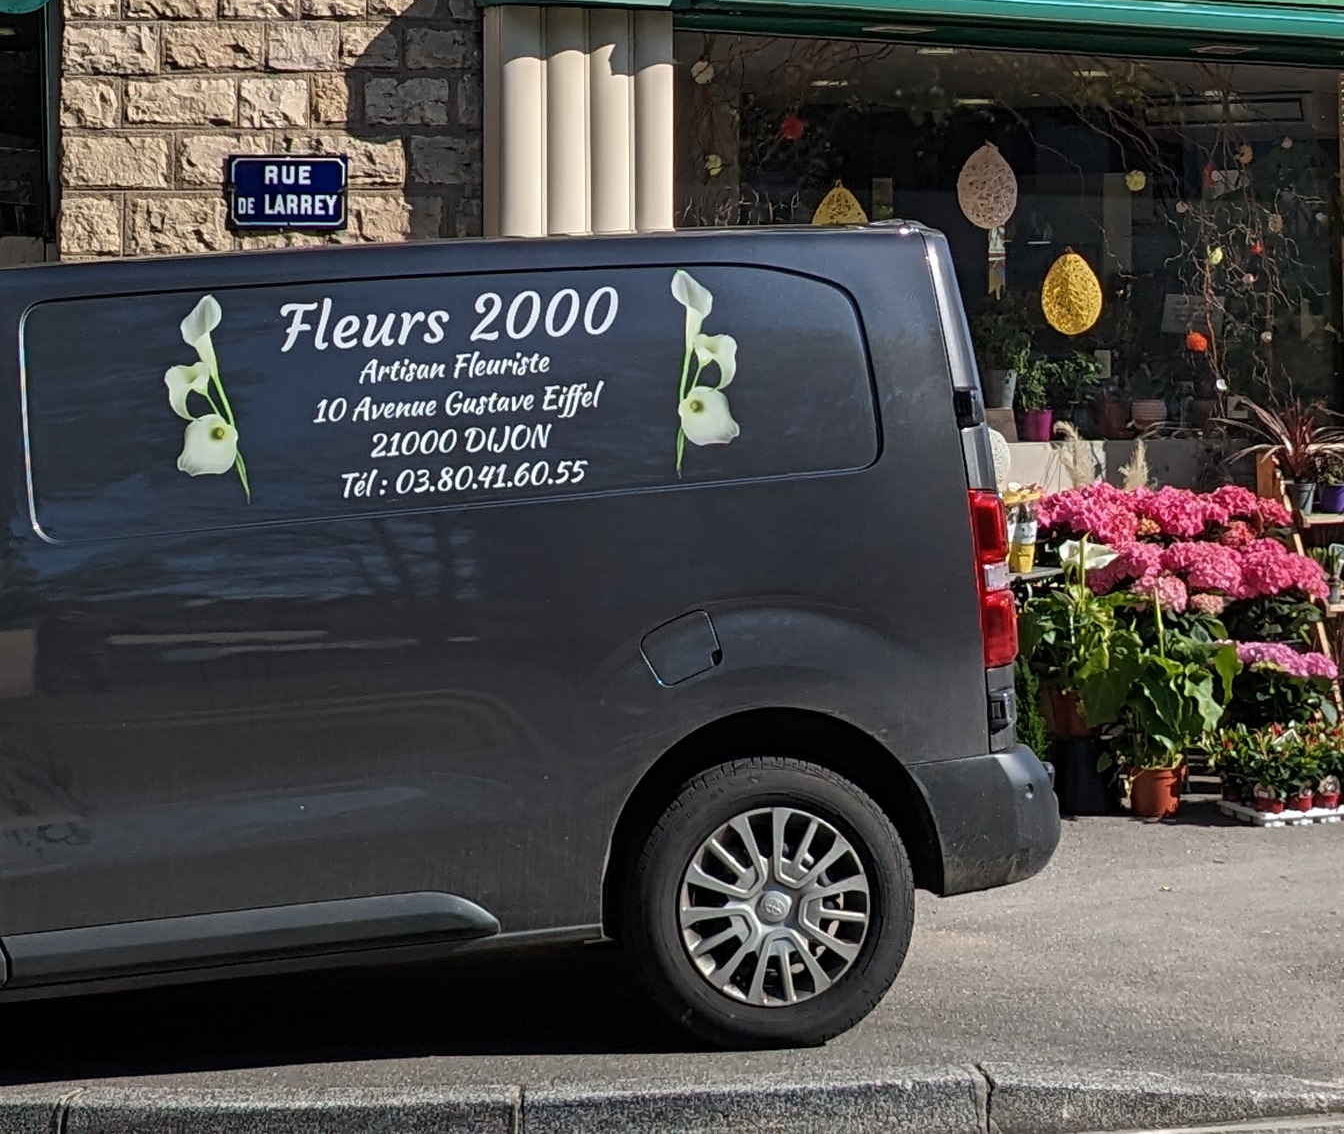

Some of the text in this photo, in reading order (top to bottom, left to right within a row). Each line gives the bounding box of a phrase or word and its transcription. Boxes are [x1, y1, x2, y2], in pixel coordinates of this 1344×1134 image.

[263, 164, 313, 185] RUE
[237, 193, 338, 216] DE LARREY
[279, 286, 619, 353] Fleurs 2000
[358, 350, 550, 385] Artisan Fleuriste
[312, 380, 605, 424] 10 Avenue Gustave Eiffel
[370, 423, 553, 459] 21000 DIJON
[395, 459, 589, 494] 03.80.41.60.55
